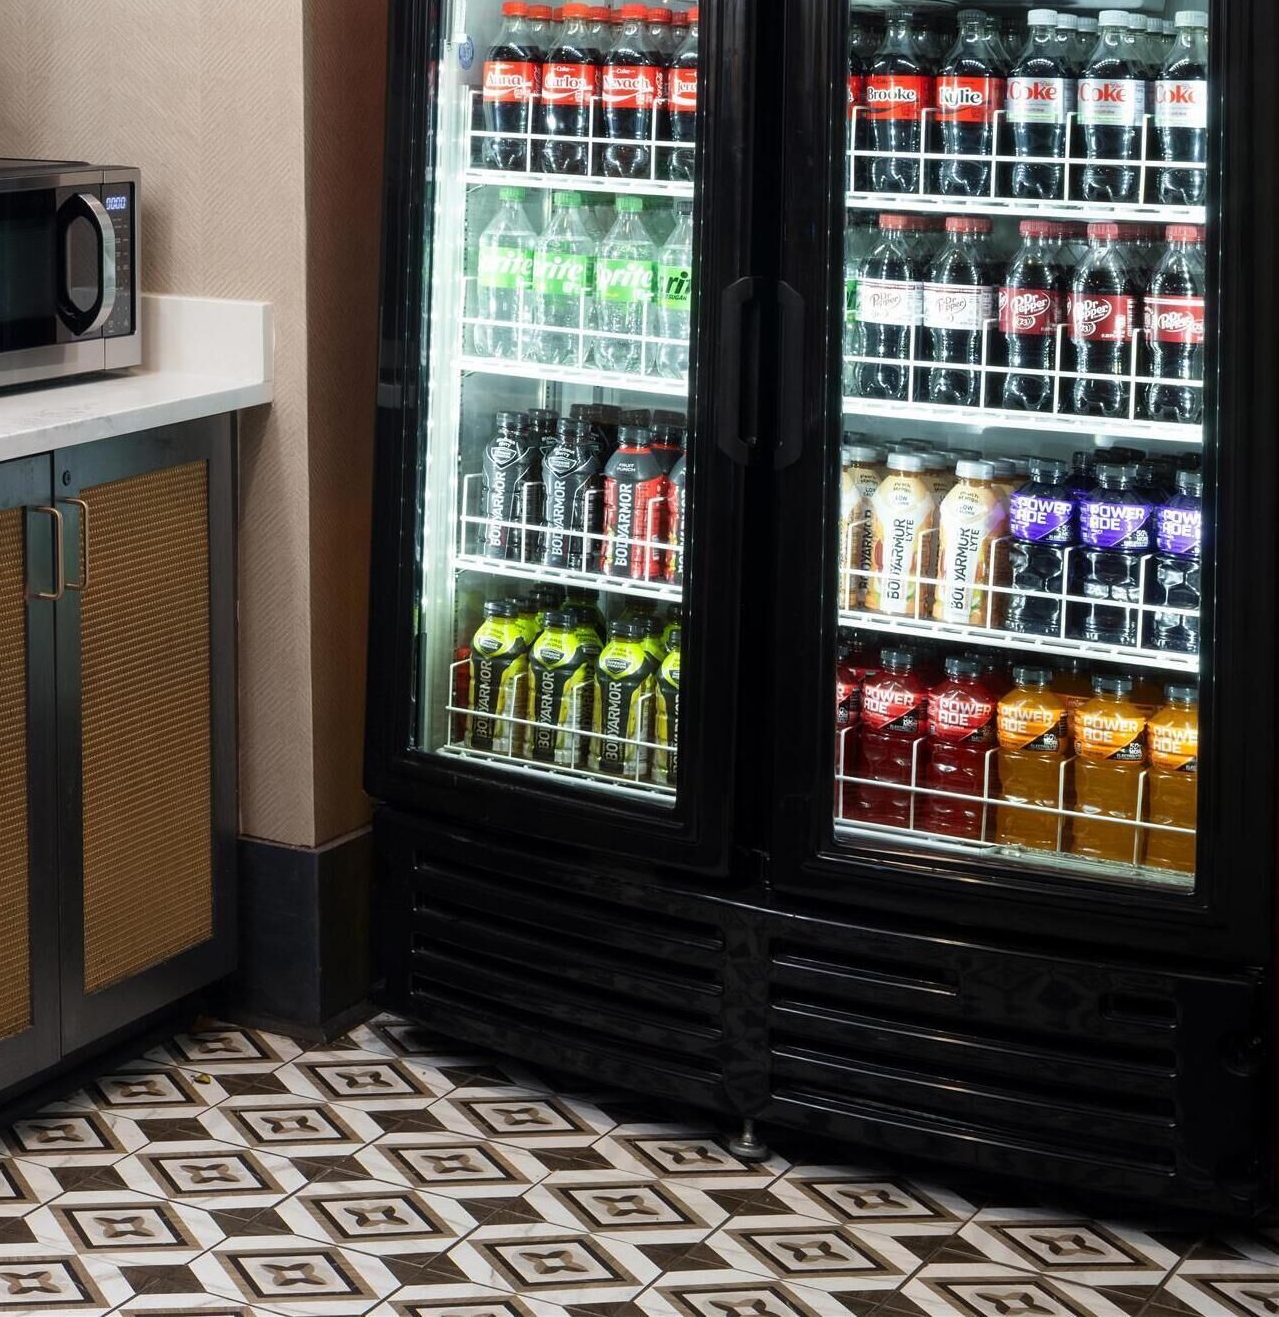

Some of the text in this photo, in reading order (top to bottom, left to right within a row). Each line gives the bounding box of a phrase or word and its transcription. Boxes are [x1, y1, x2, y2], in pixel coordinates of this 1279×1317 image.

[866, 86, 917, 102] Brooke
[939, 87, 983, 106] Kylie
[1009, 80, 1058, 101] Coke
[1078, 81, 1127, 103] Coke
[1010, 298, 1049, 317] Pepper
[1023, 295, 1039, 307] Dr
[1082, 299, 1099, 311] Dr
[1019, 495, 1072, 514] POWER
[1090, 501, 1145, 520] POWER
[1016, 510, 1047, 525] ADE
[1089, 516, 1122, 532] ADE
[906, 518, 915, 543] LYTE
[969, 528, 981, 552] LYTE
[865, 685, 914, 706] POWER
[863, 698, 889, 715] ADE
[940, 697, 992, 716] POWER
[1000, 704, 1053, 724] POWER
[938, 711, 969, 728] ADE
[1083, 715, 1139, 733] POWER
